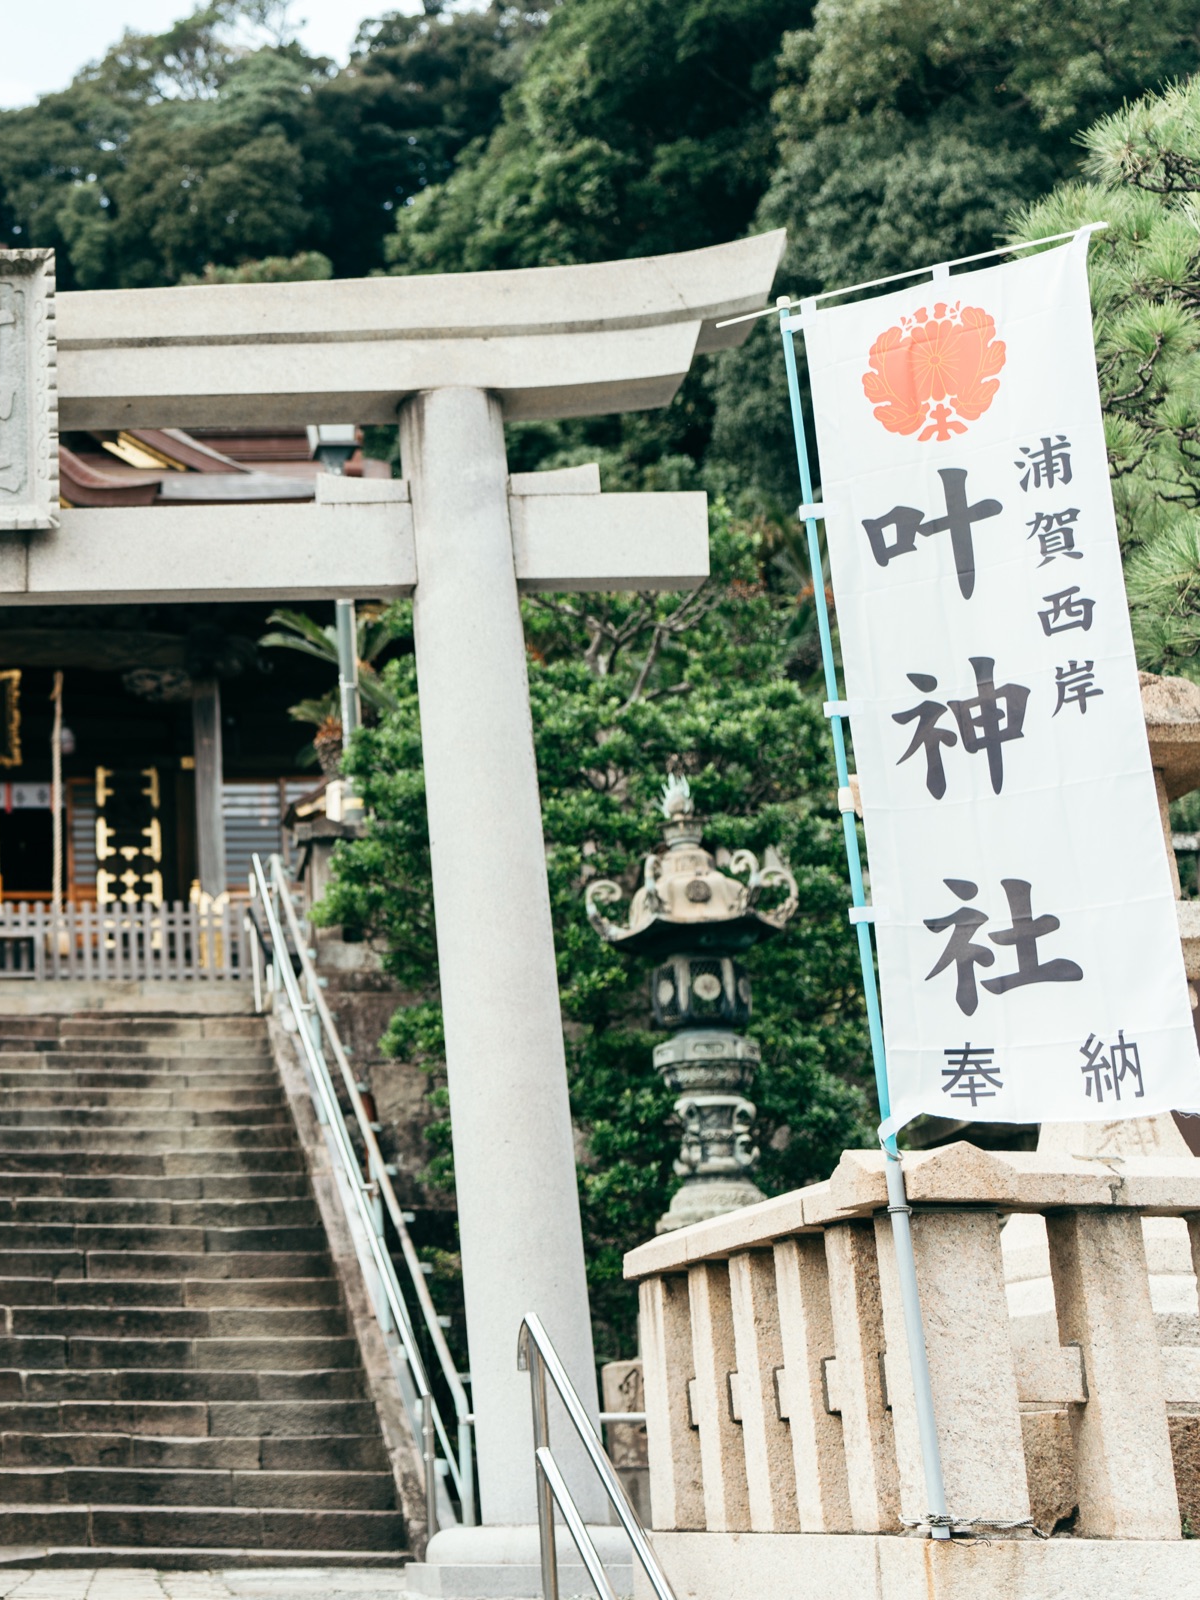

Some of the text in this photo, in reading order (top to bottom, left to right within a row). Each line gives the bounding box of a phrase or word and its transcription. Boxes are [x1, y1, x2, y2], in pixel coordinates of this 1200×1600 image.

[862, 467, 1084, 1017] 叶神社
[1013, 434, 1105, 718] 浦賀西岸
